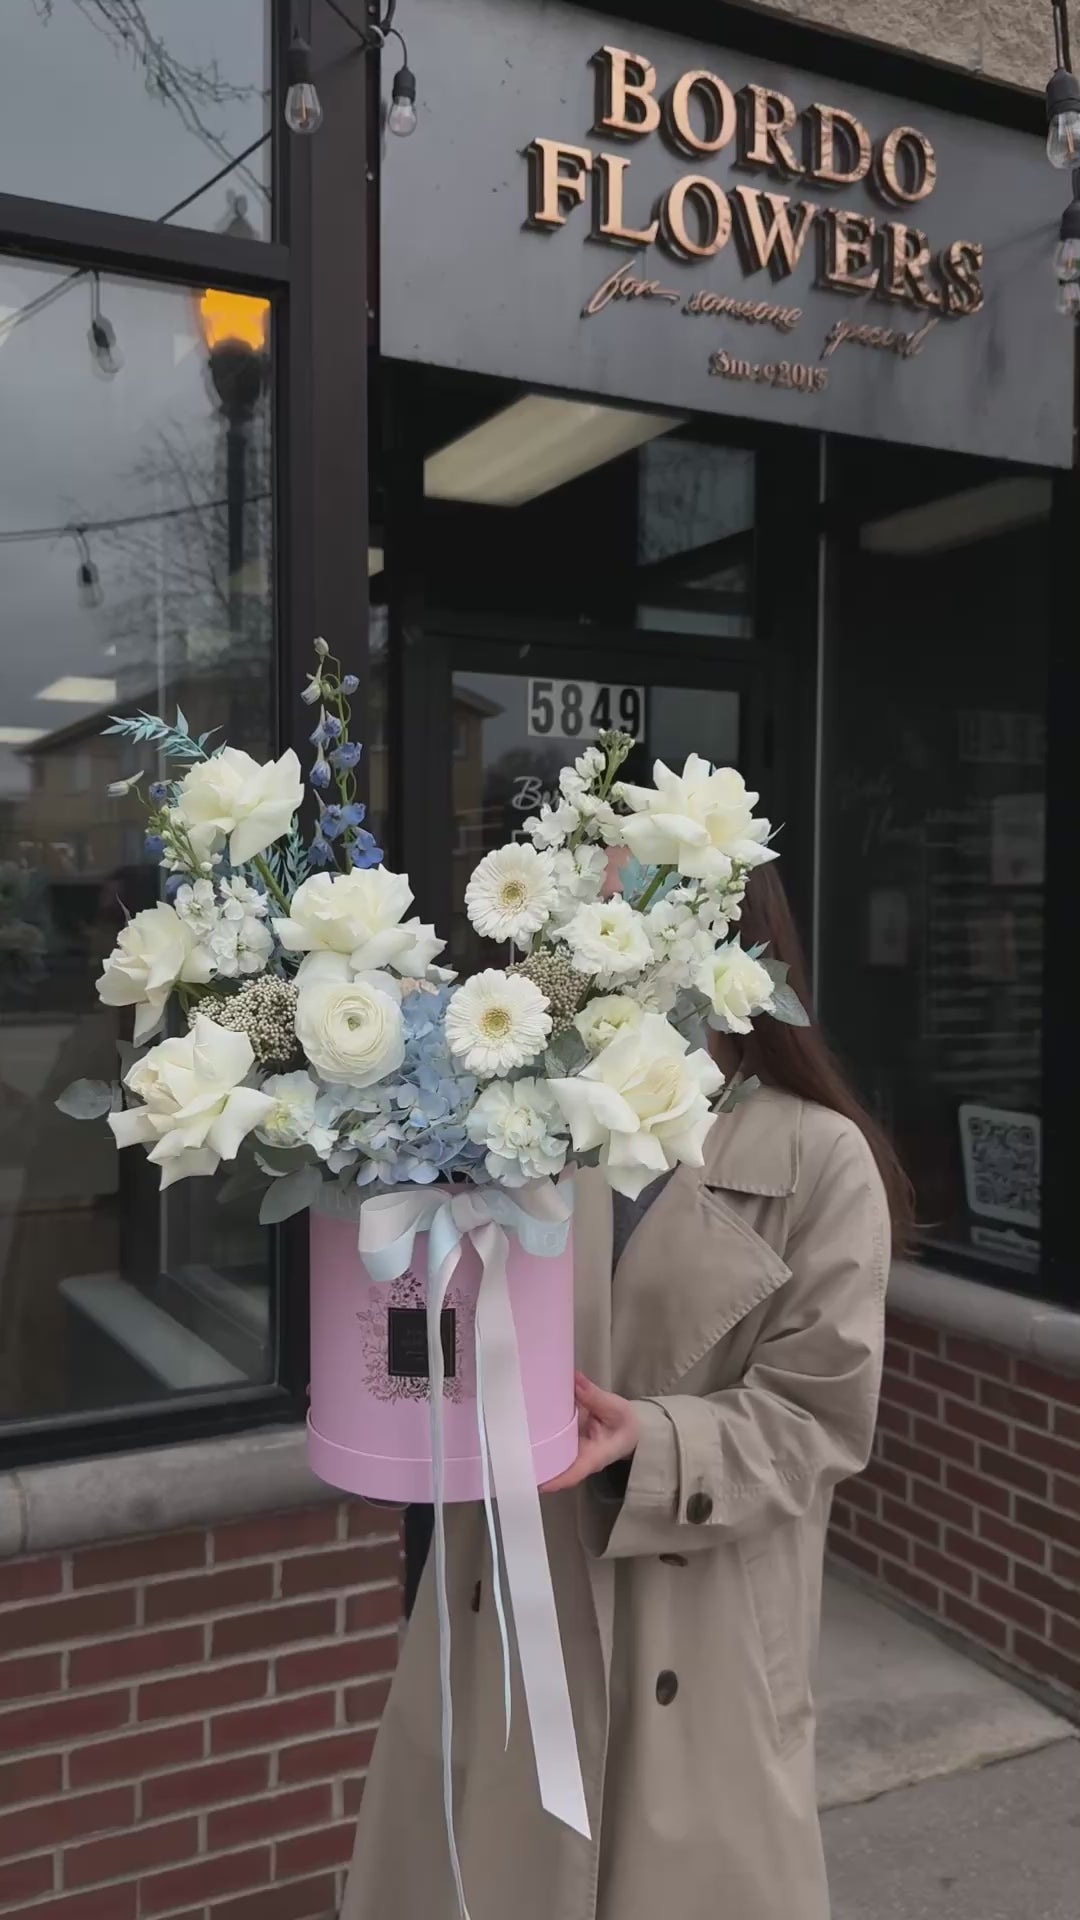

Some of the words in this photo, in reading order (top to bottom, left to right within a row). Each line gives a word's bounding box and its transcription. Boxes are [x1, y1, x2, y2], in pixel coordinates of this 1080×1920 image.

[594, 45, 938, 203] BORDO
[526, 137, 985, 316] FLOWERS
[687, 289, 803, 331] someone
[530, 680, 642, 740] 5849
